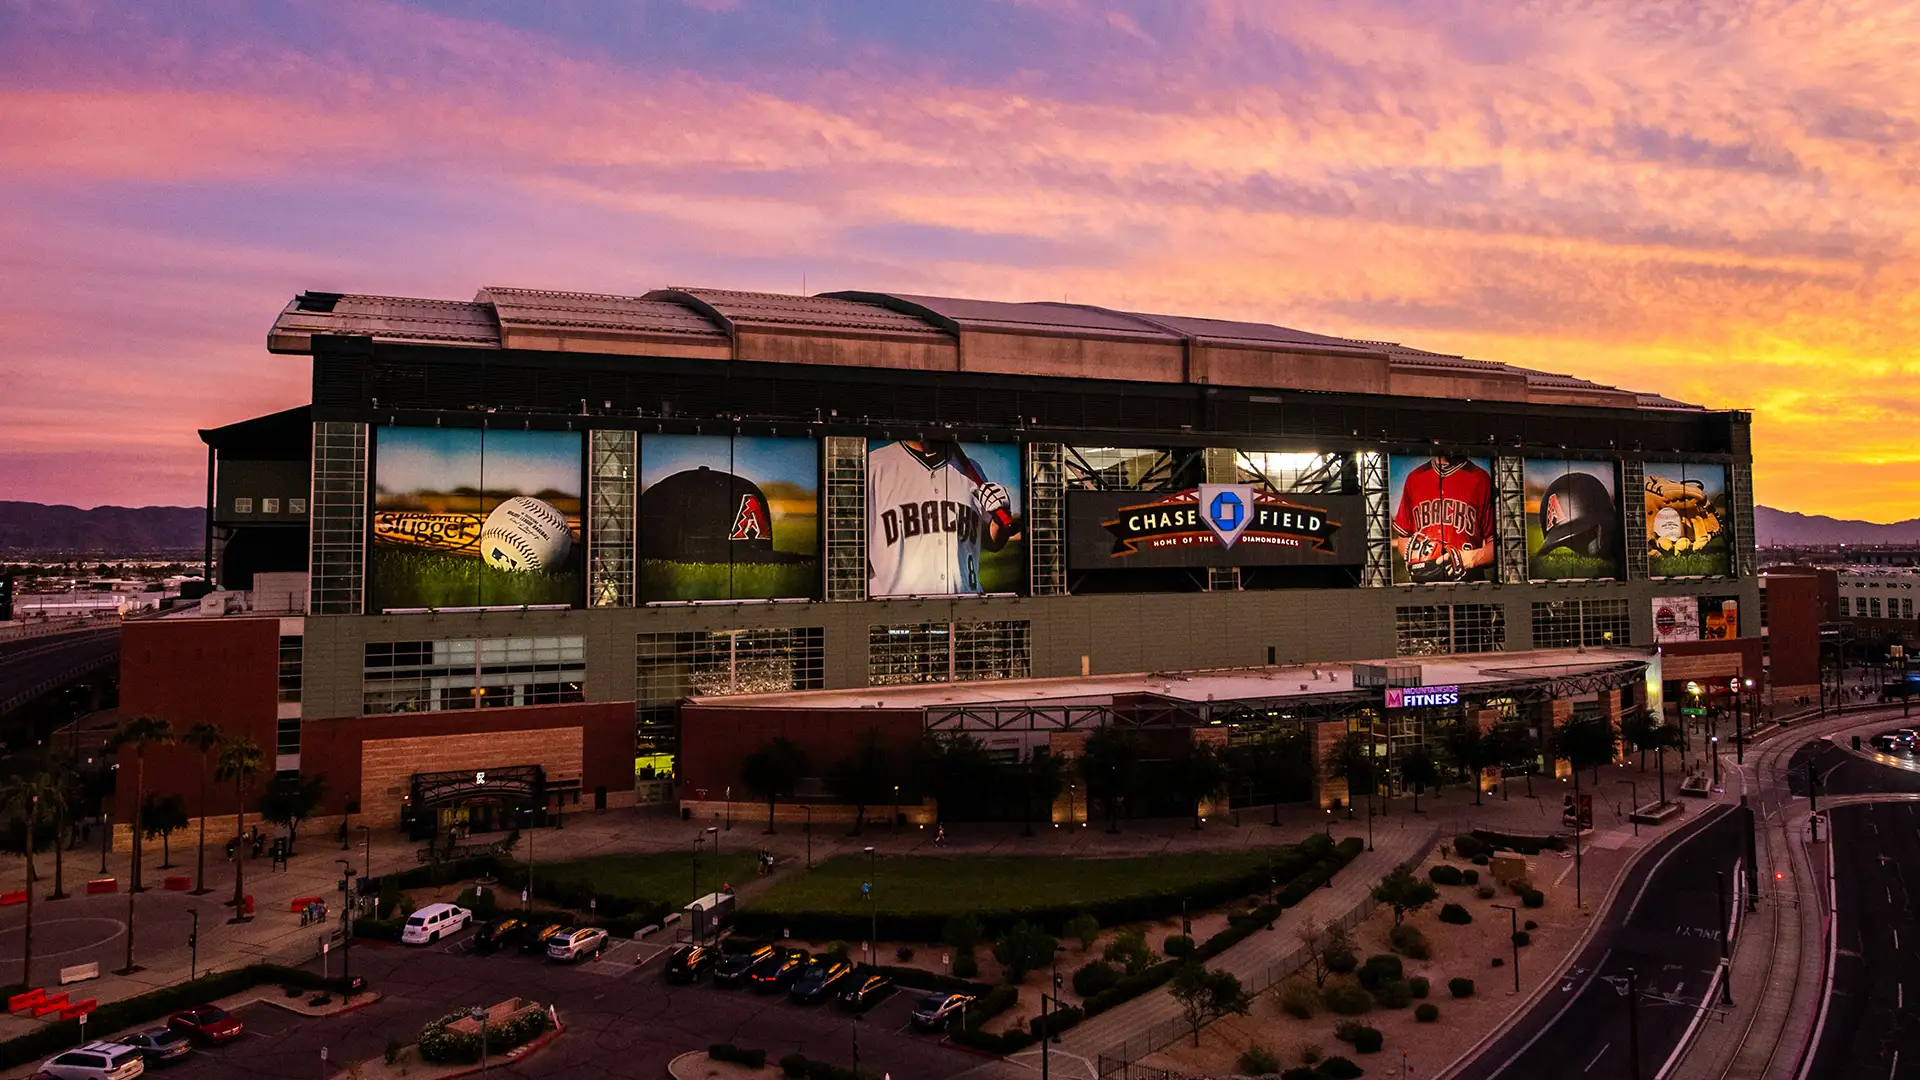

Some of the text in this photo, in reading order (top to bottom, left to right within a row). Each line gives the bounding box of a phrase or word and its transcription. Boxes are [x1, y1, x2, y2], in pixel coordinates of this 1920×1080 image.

[378, 513, 474, 544] Slugger
[1128, 510, 1321, 531] CHASE FIELD
[1153, 538, 1177, 547] HOME
[1182, 537, 1193, 545] OF
[1242, 536, 1299, 547] DIAMONDBACKS
[1404, 693, 1459, 707] FITNESS
